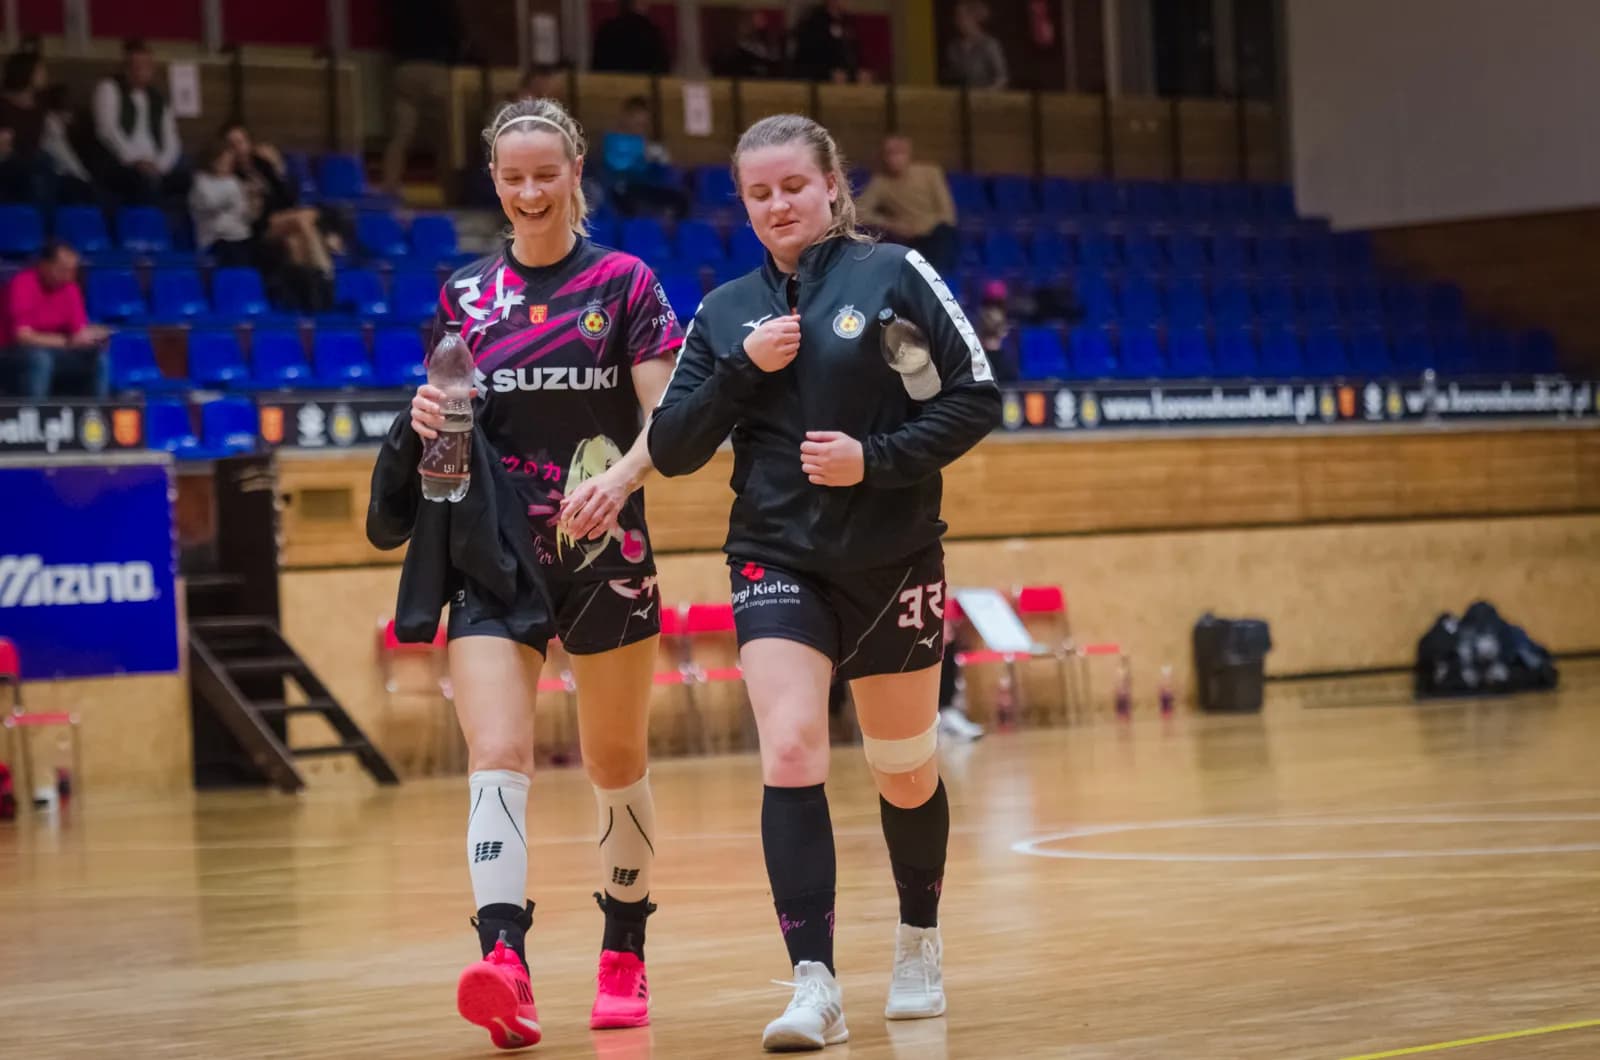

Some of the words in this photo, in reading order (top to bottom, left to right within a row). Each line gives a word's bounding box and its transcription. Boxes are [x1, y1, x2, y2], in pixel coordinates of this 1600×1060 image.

[454, 265, 526, 321] 24
[492, 365, 618, 393] SUZUKI
[732, 586, 750, 604] argi
[753, 581, 800, 596] Kielce
